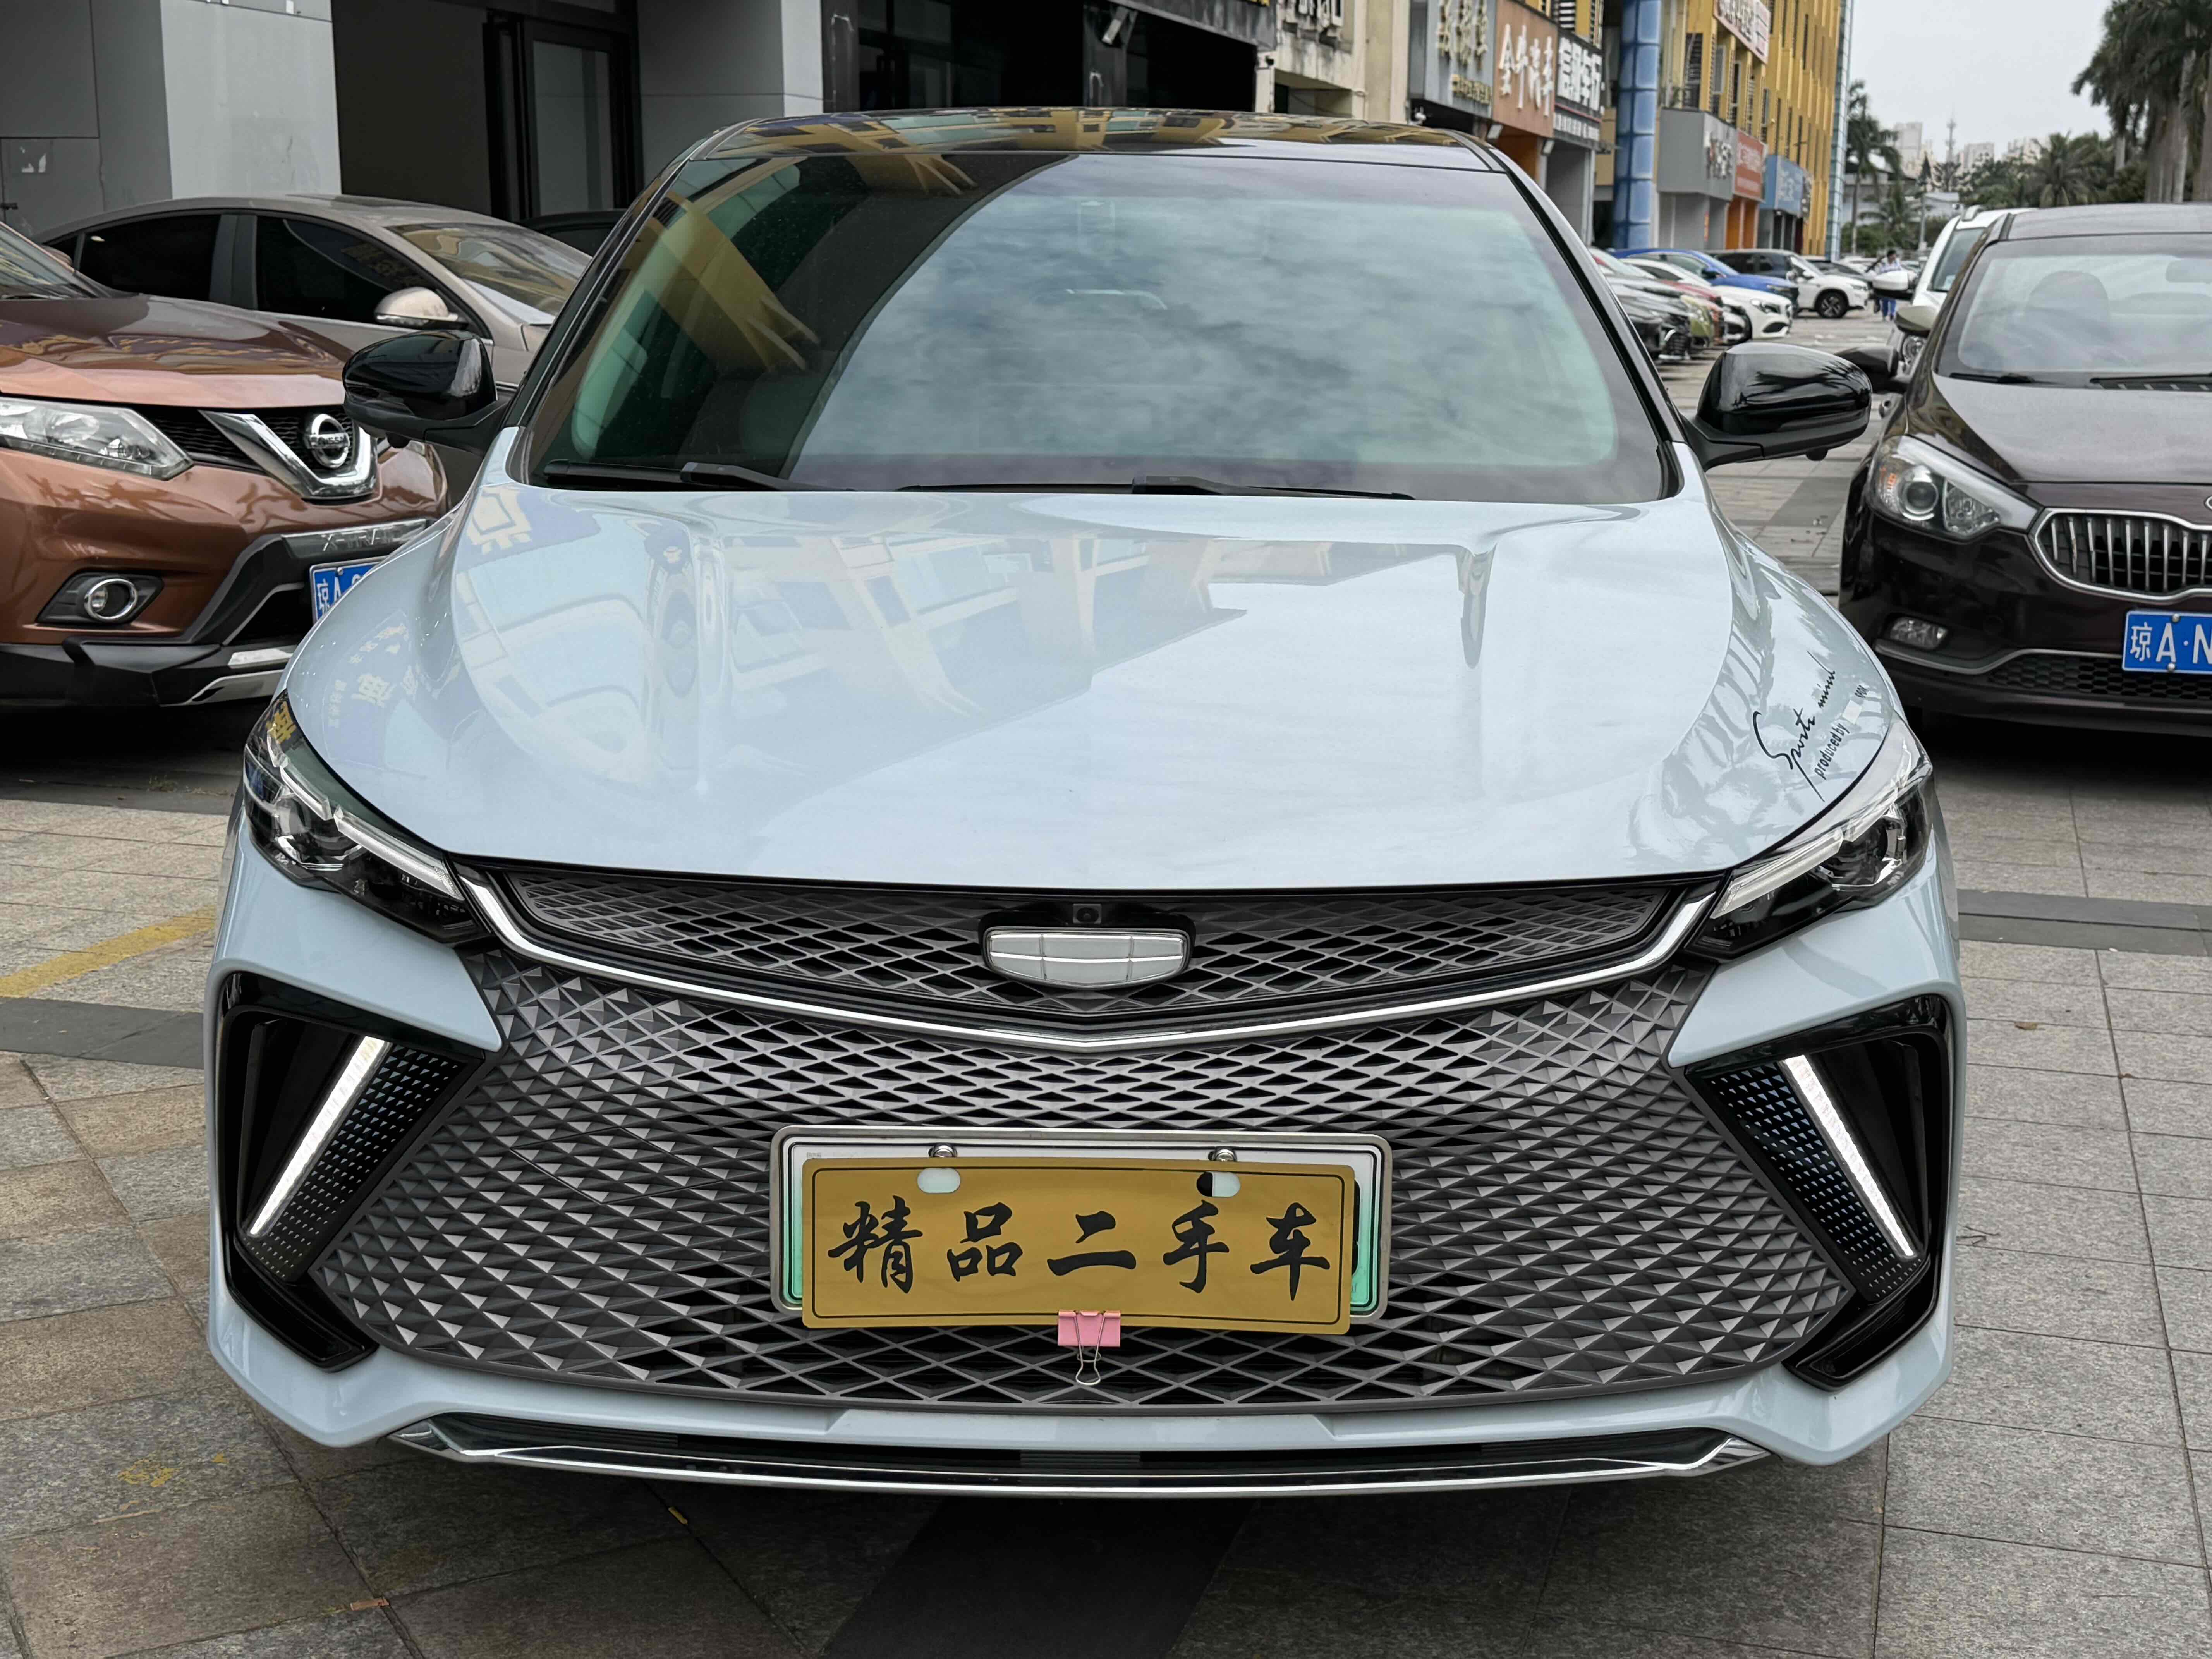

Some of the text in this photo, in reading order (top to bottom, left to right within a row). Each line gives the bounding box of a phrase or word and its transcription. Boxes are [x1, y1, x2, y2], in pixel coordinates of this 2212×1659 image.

[1814, 731, 1842, 780] produced
[1831, 723, 1850, 736] by
[828, 1195, 1330, 1301] 精品二手车
